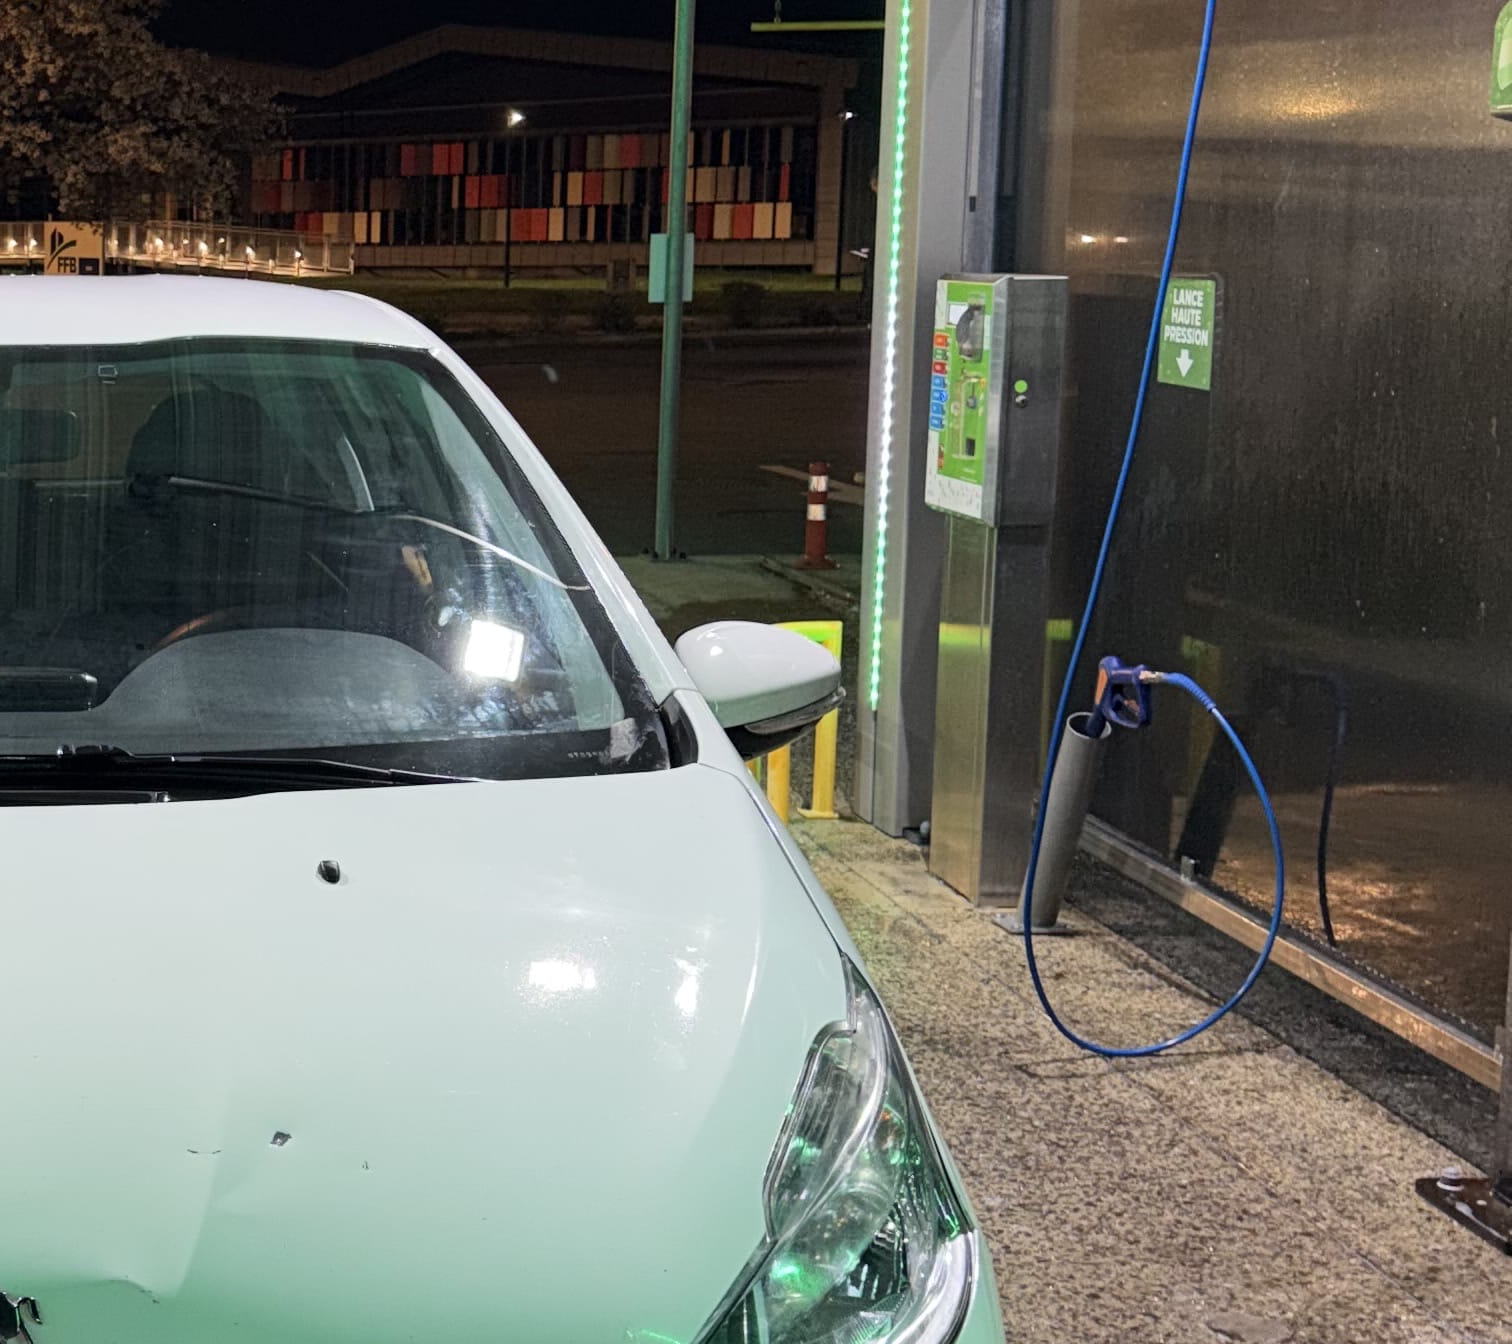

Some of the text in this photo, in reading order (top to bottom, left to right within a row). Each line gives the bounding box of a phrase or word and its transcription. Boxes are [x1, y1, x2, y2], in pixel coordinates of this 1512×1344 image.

[1173, 288, 1204, 306] LANCE
[1171, 307, 1201, 326] HAUTE
[1164, 325, 1208, 346] PRESSION
